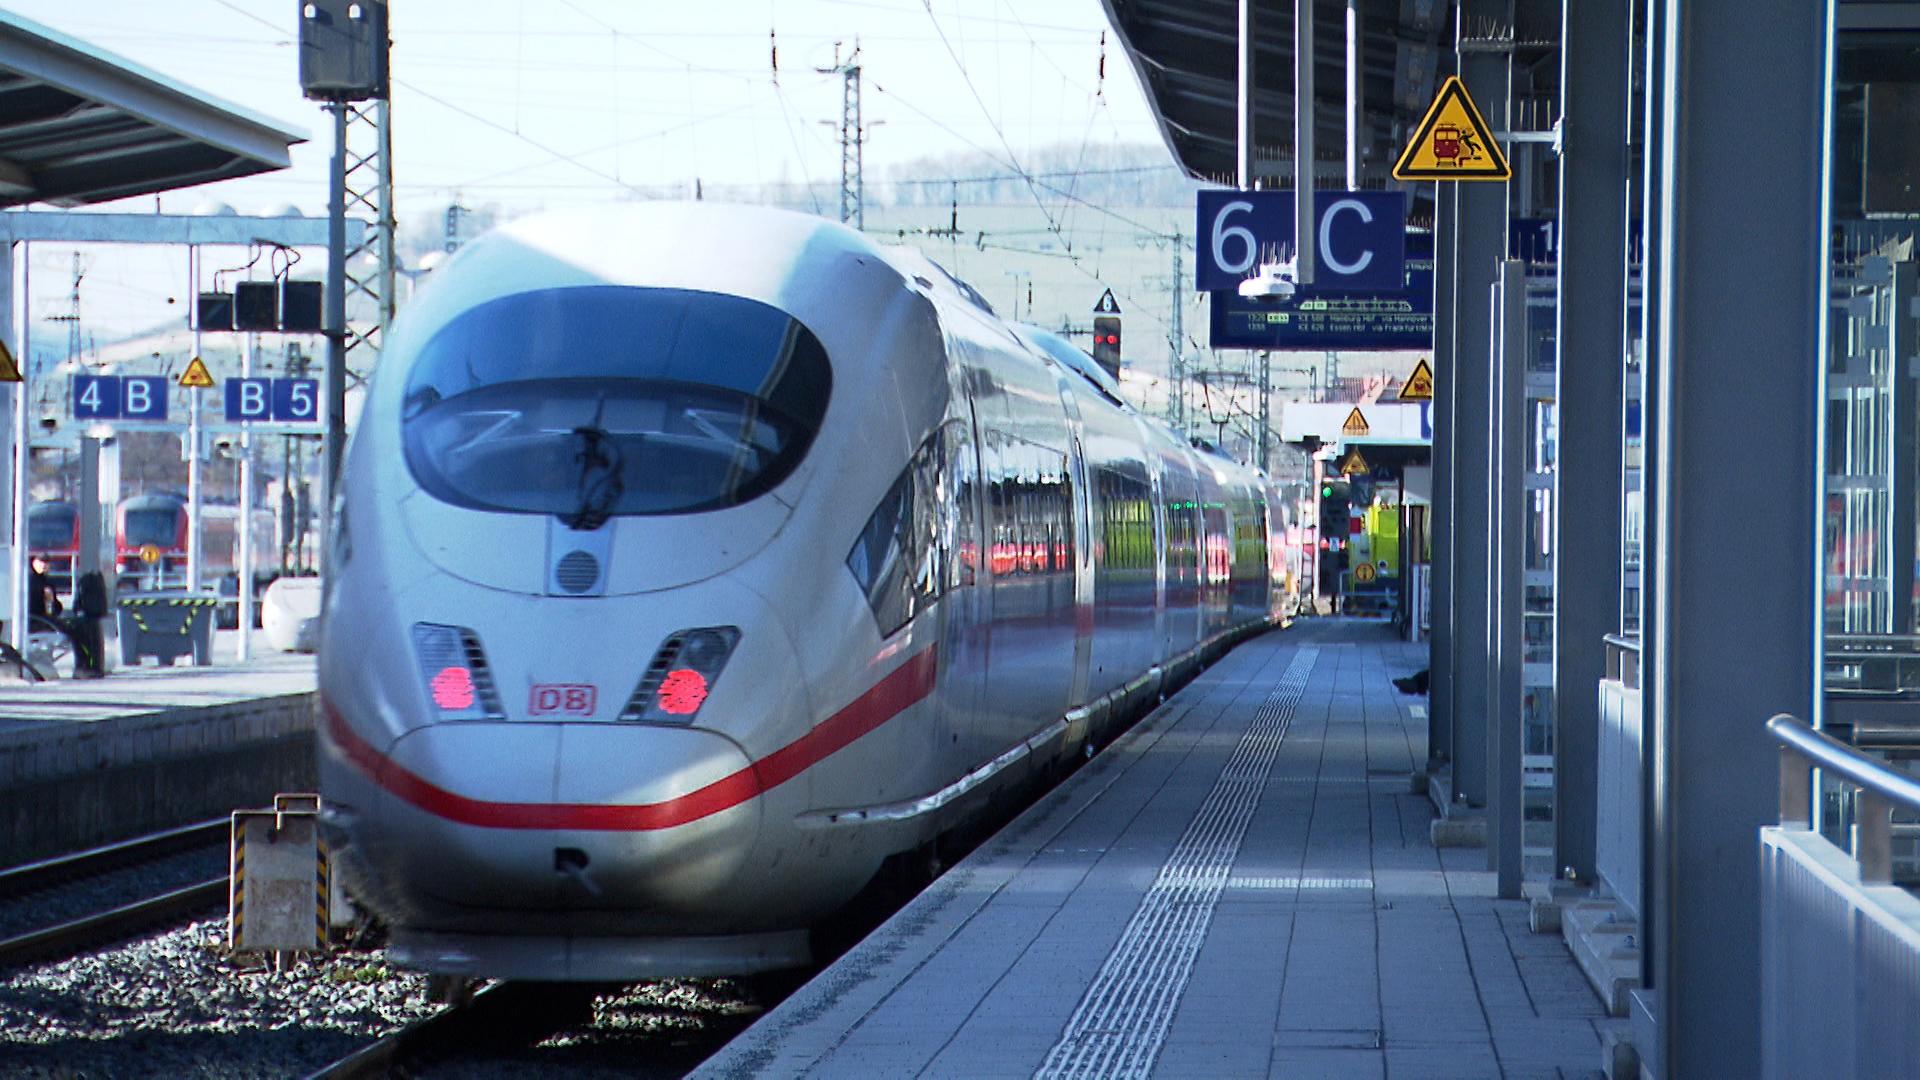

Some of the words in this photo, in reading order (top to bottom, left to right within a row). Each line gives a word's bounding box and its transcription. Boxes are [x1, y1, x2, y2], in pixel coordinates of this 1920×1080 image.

[1211, 200, 1258, 275] 6
[1319, 199, 1374, 275] C
[80, 380, 101, 413] 4
[127, 379, 151, 413] B
[240, 382, 265, 415] B
[291, 383, 312, 416] 5
